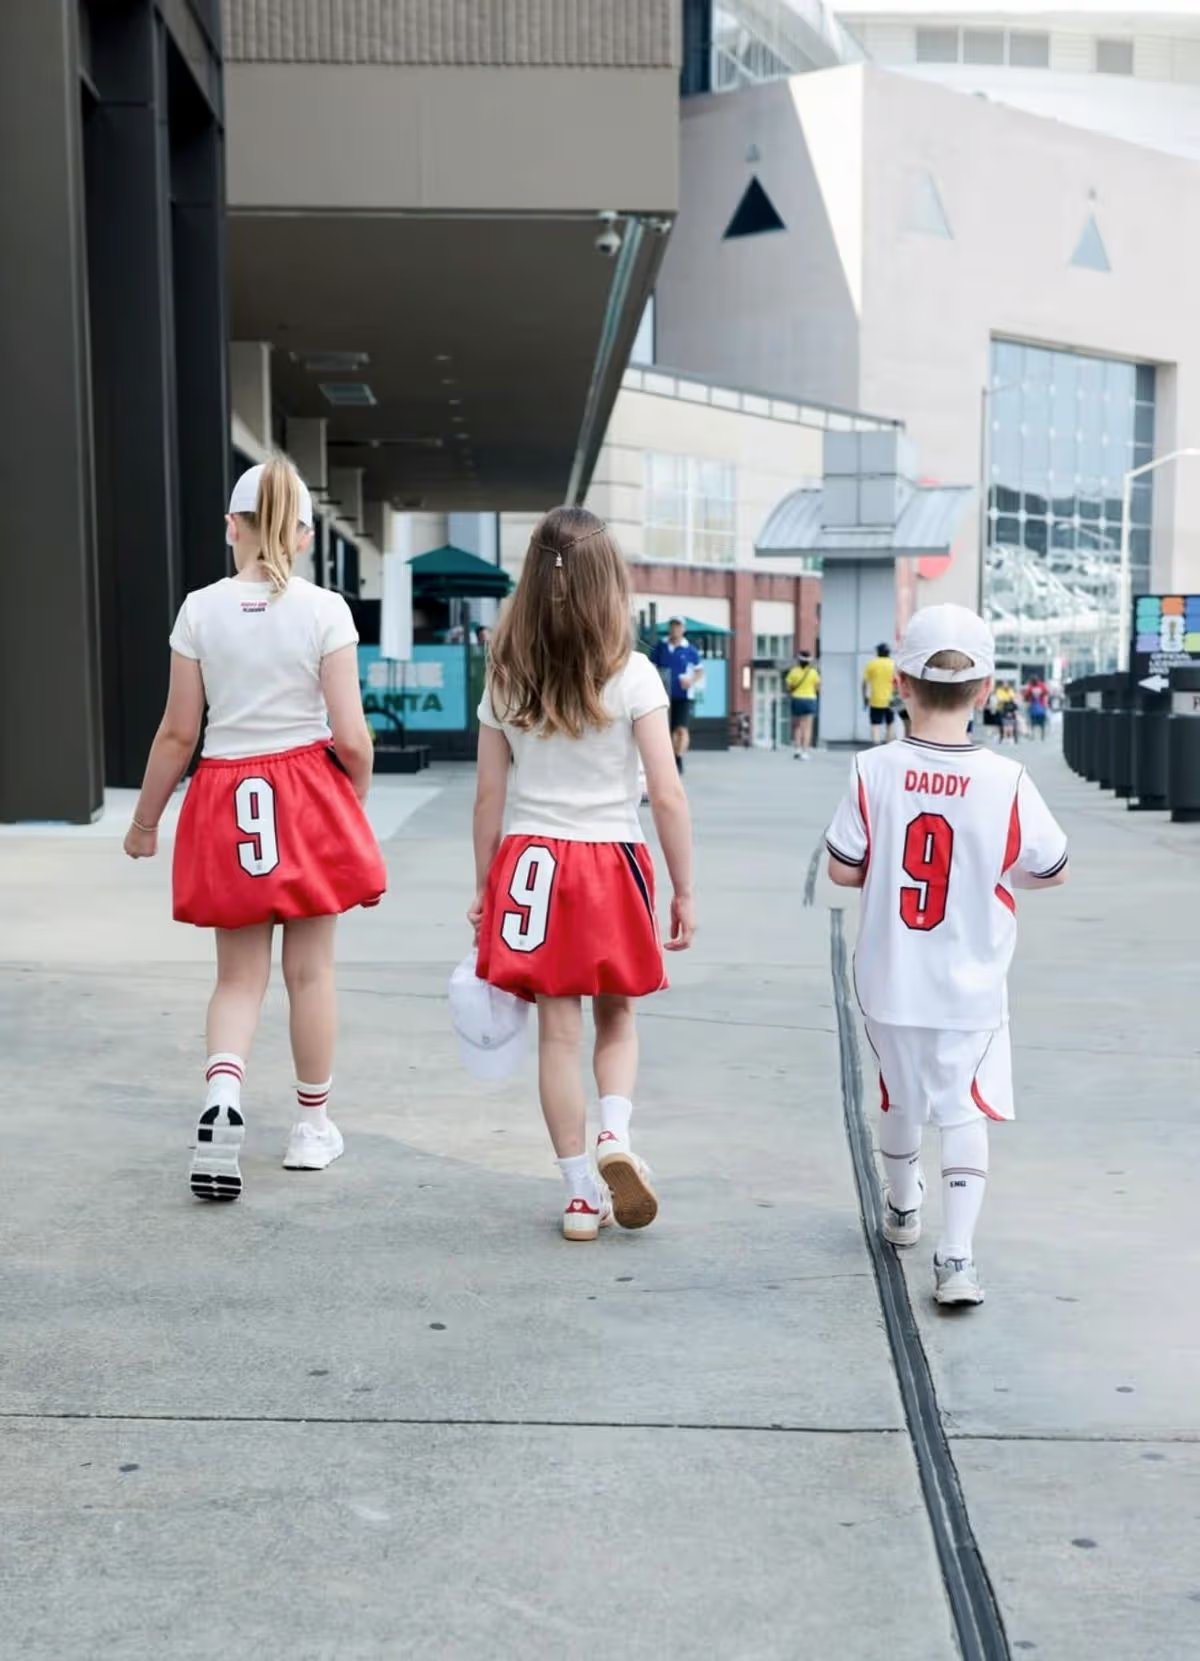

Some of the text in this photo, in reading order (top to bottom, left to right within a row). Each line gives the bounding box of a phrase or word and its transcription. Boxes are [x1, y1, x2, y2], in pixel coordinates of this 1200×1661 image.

[234, 776, 280, 878] 9
[904, 769, 971, 797] DADDY
[500, 843, 558, 954] 9
[899, 811, 954, 931] 9
